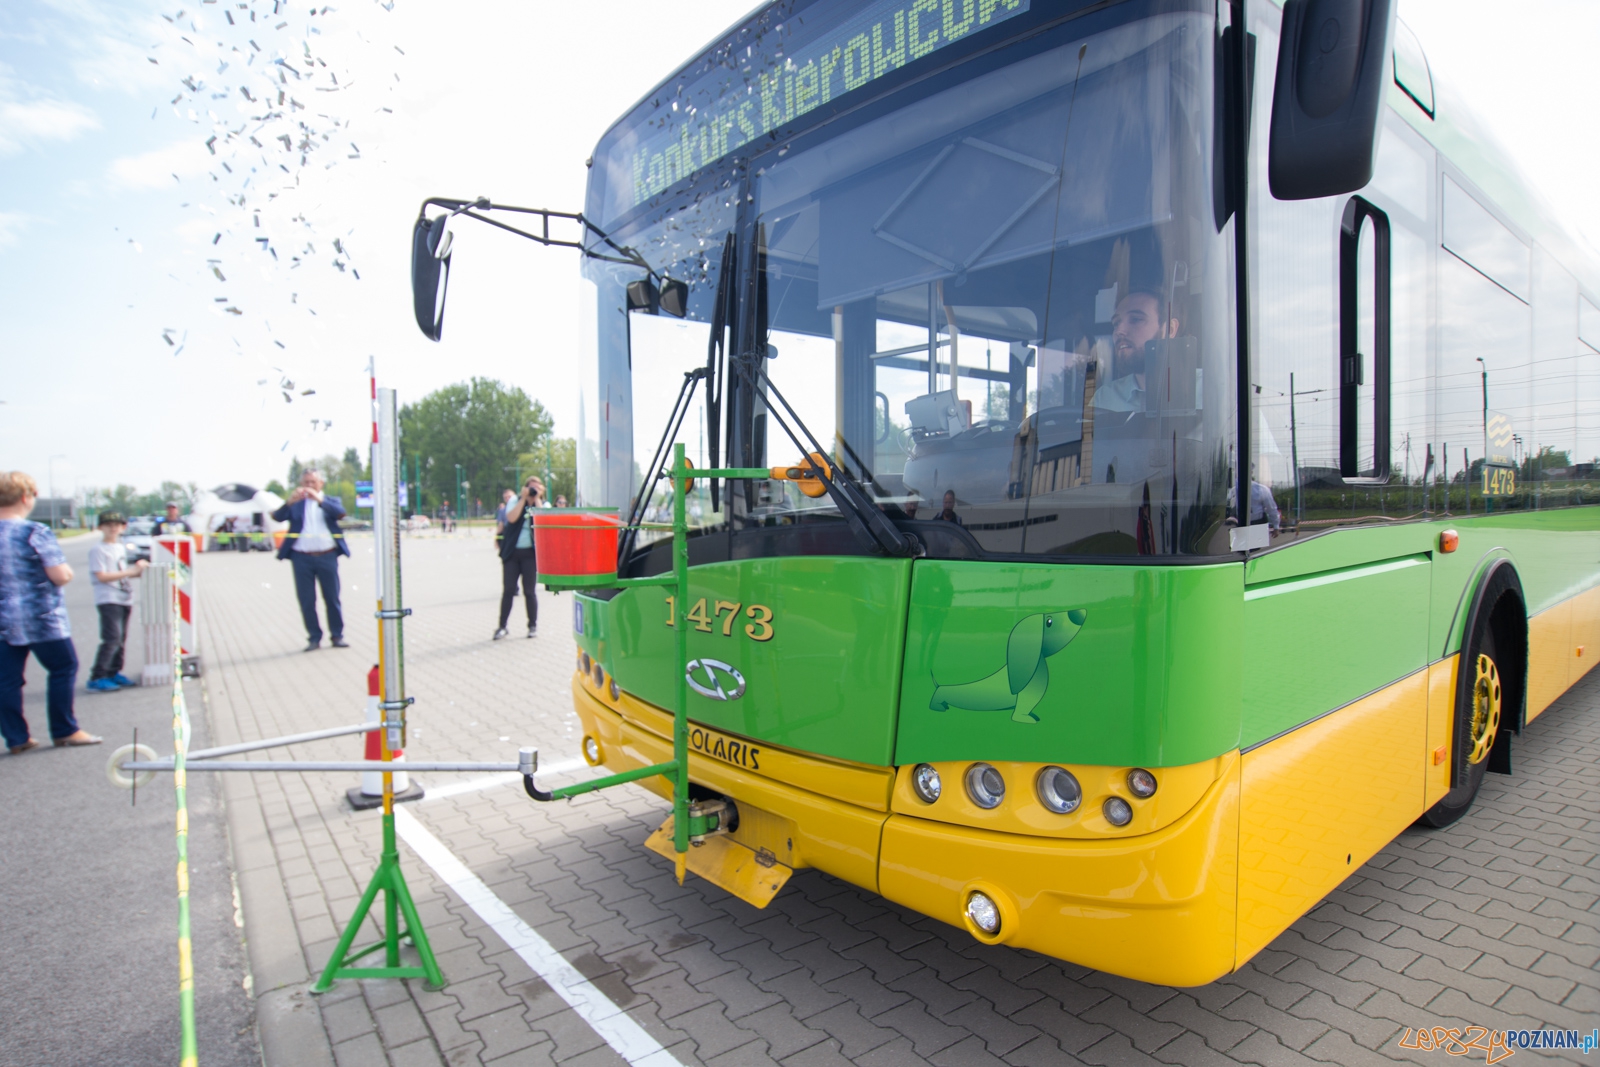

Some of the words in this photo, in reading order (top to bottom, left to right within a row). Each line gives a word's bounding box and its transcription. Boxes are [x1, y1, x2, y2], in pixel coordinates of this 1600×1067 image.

[633, 100, 755, 205] Konkurs
[760, 0, 1020, 133] Kierowc
[1482, 467, 1515, 495] 1473
[665, 595, 774, 641] 1473
[691, 728, 760, 770] OLARIS
